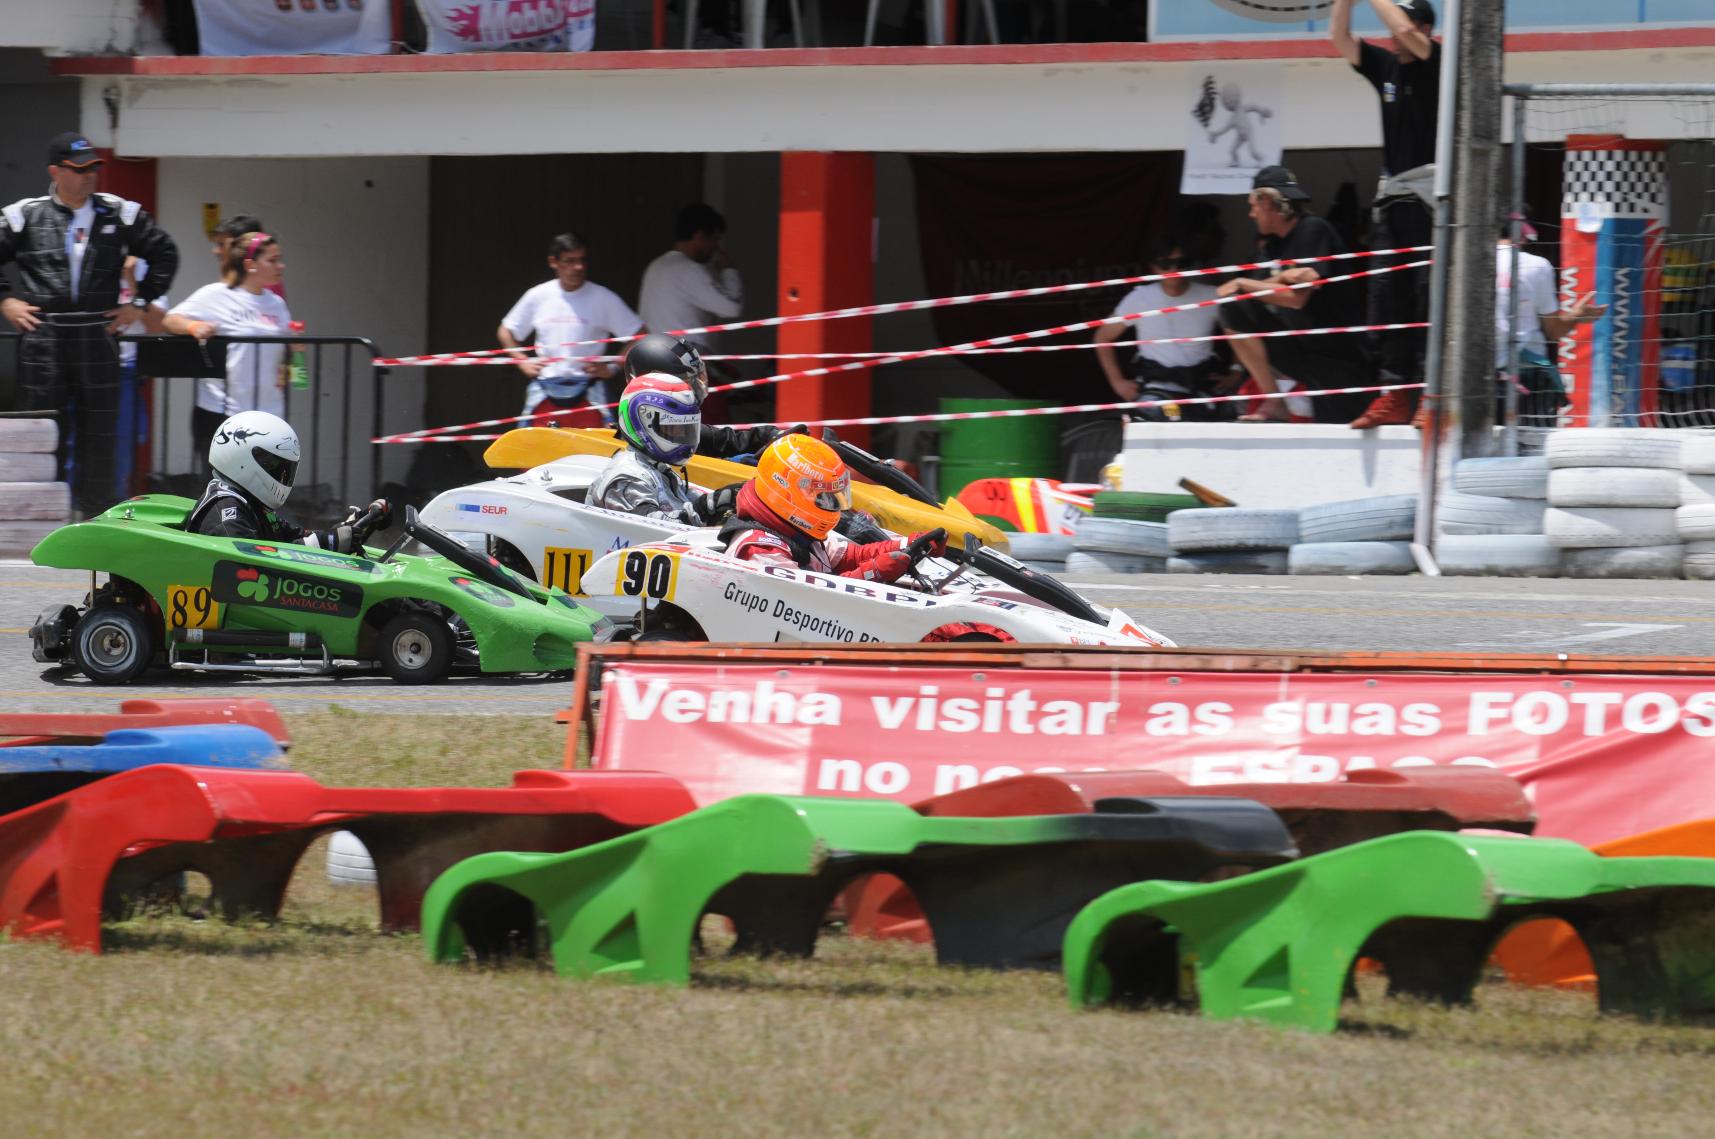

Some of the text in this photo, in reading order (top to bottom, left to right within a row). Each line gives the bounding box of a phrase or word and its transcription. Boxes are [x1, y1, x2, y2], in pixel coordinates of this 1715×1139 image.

[787, 453, 824, 481] Marlboro
[481, 505, 508, 515] SEUR
[273, 577, 342, 601] JOGOS
[546, 551, 587, 595] 111
[622, 550, 673, 600] 90
[171, 587, 213, 628] 89
[724, 582, 853, 643] Grupo Desportivo
[616, 677, 1715, 738] Venha visitar as suas FOTOS
[818, 758, 911, 795] no
